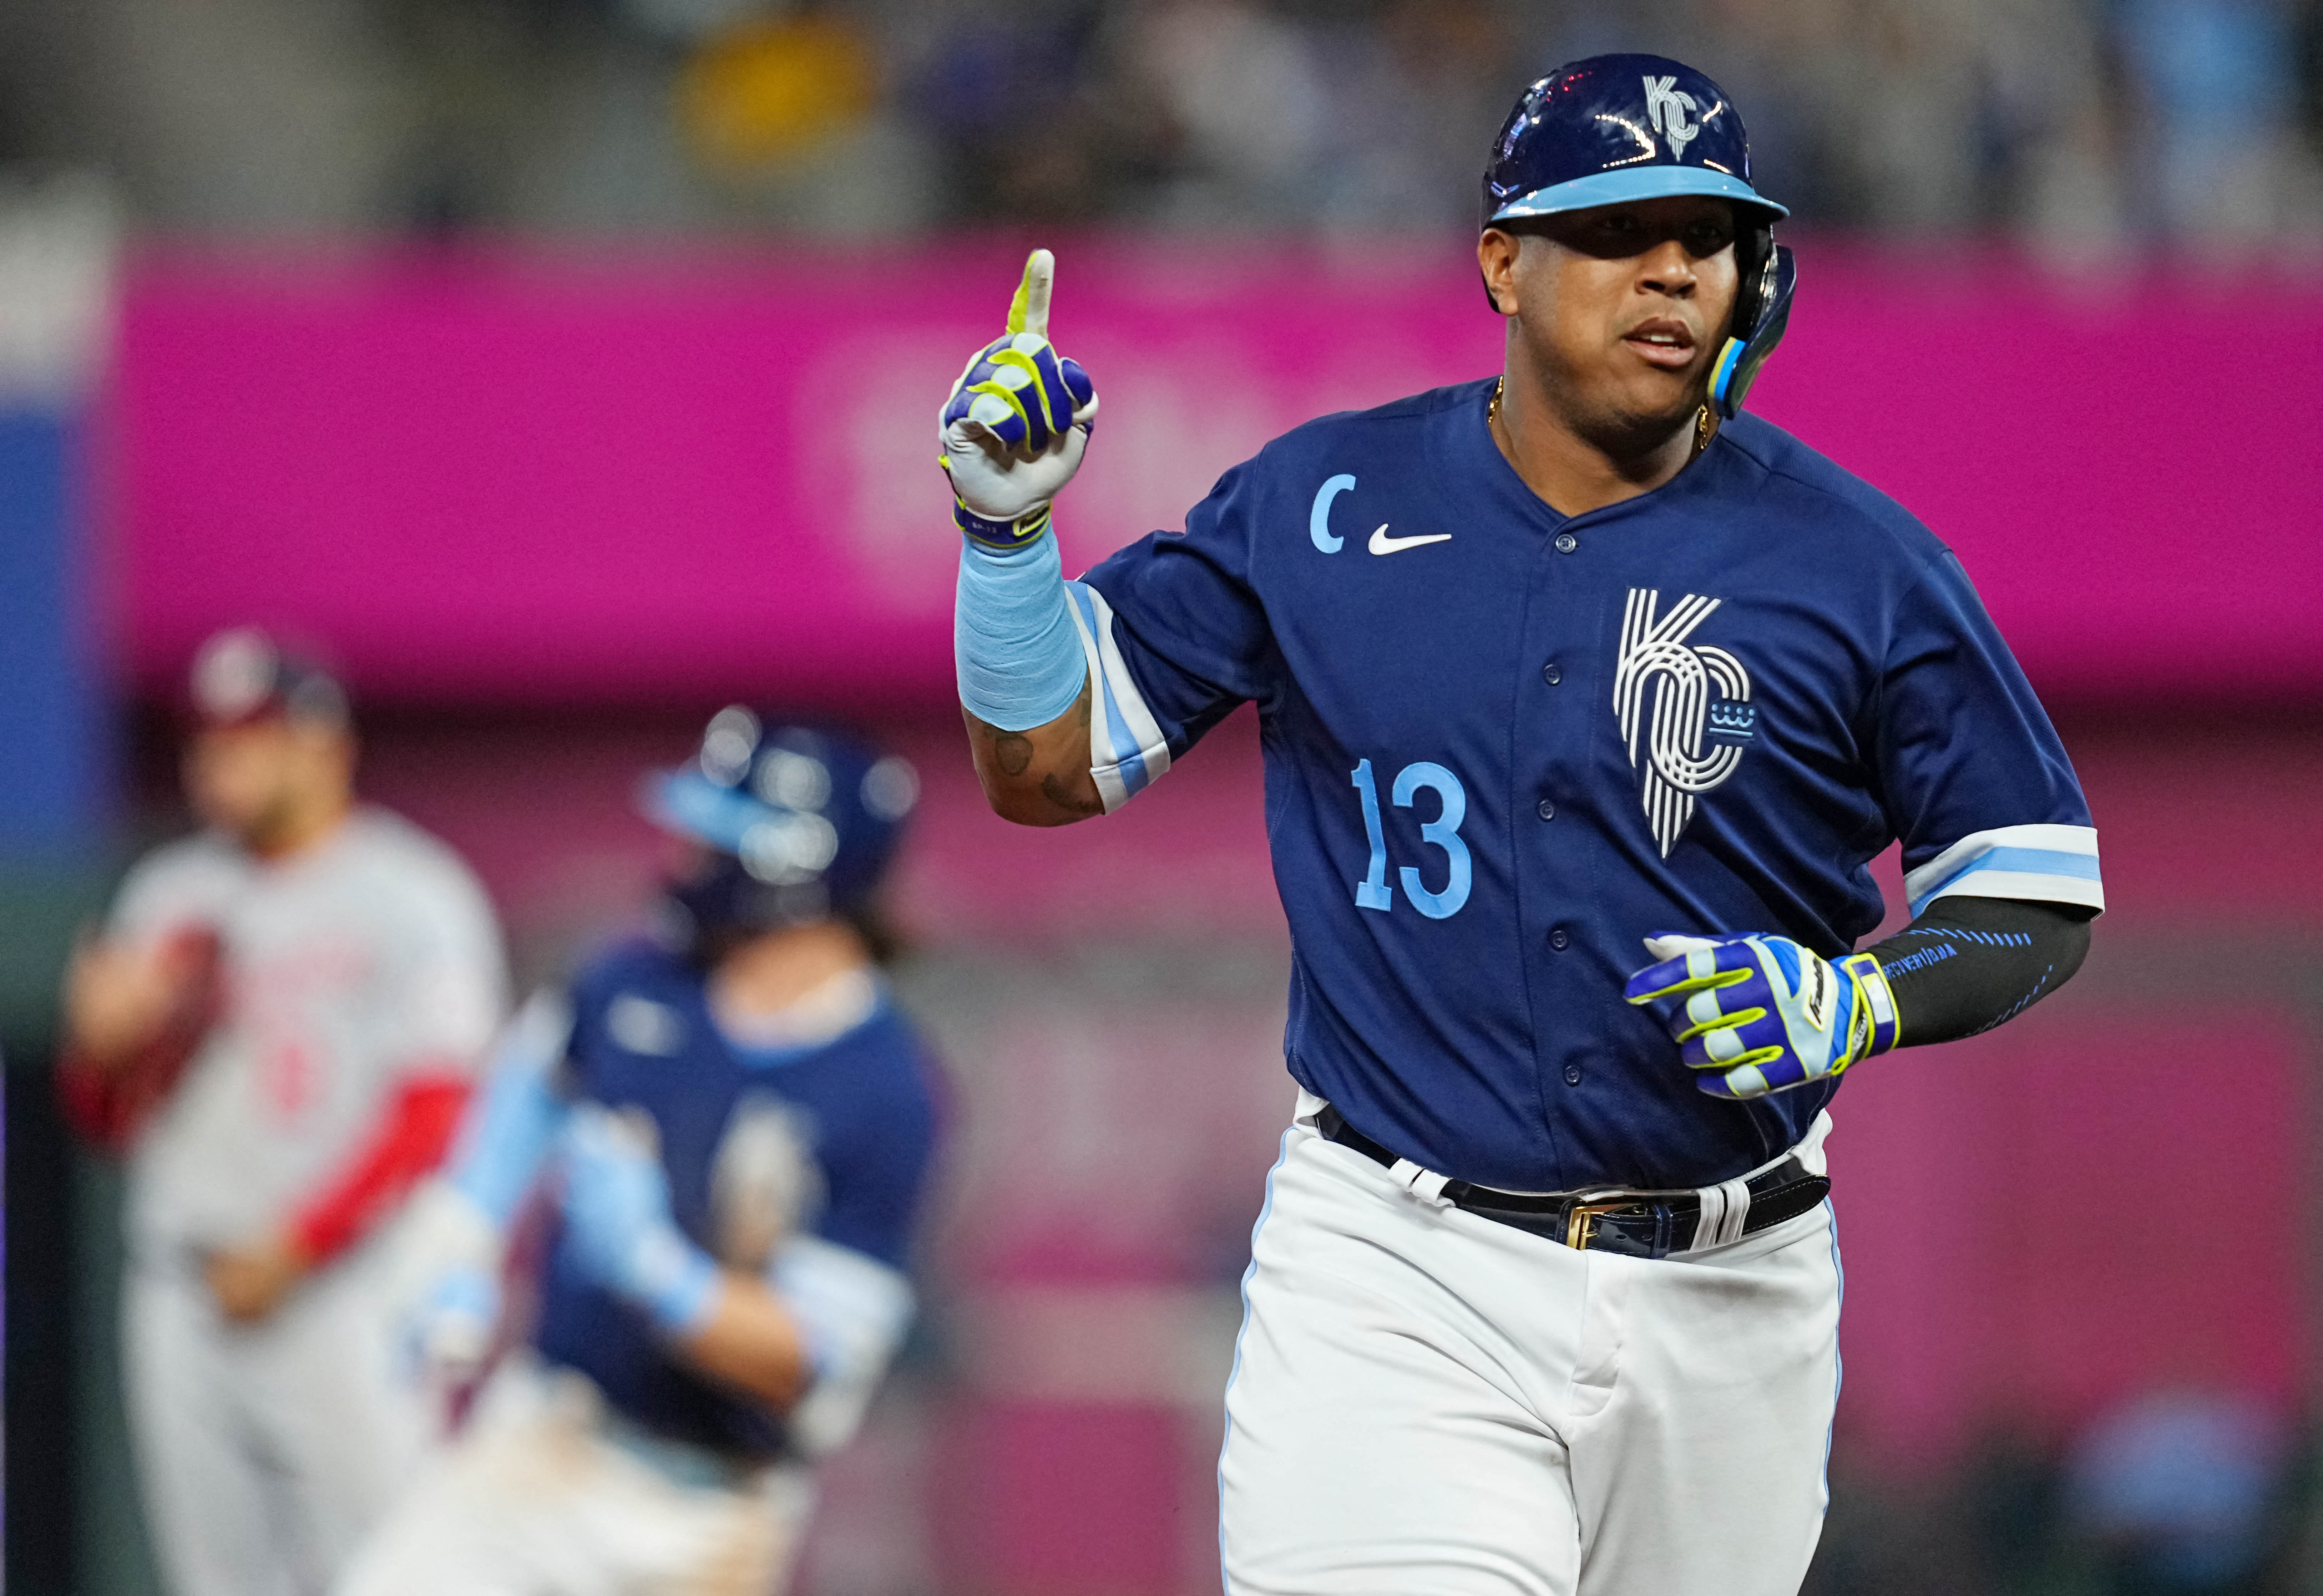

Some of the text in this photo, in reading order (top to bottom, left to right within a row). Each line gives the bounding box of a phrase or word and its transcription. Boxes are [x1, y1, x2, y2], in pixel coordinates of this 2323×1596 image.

[1642, 75, 1700, 162] KC
[1310, 473, 1356, 554] C
[1613, 588, 1751, 858] KC
[1351, 758, 1472, 919] 13
